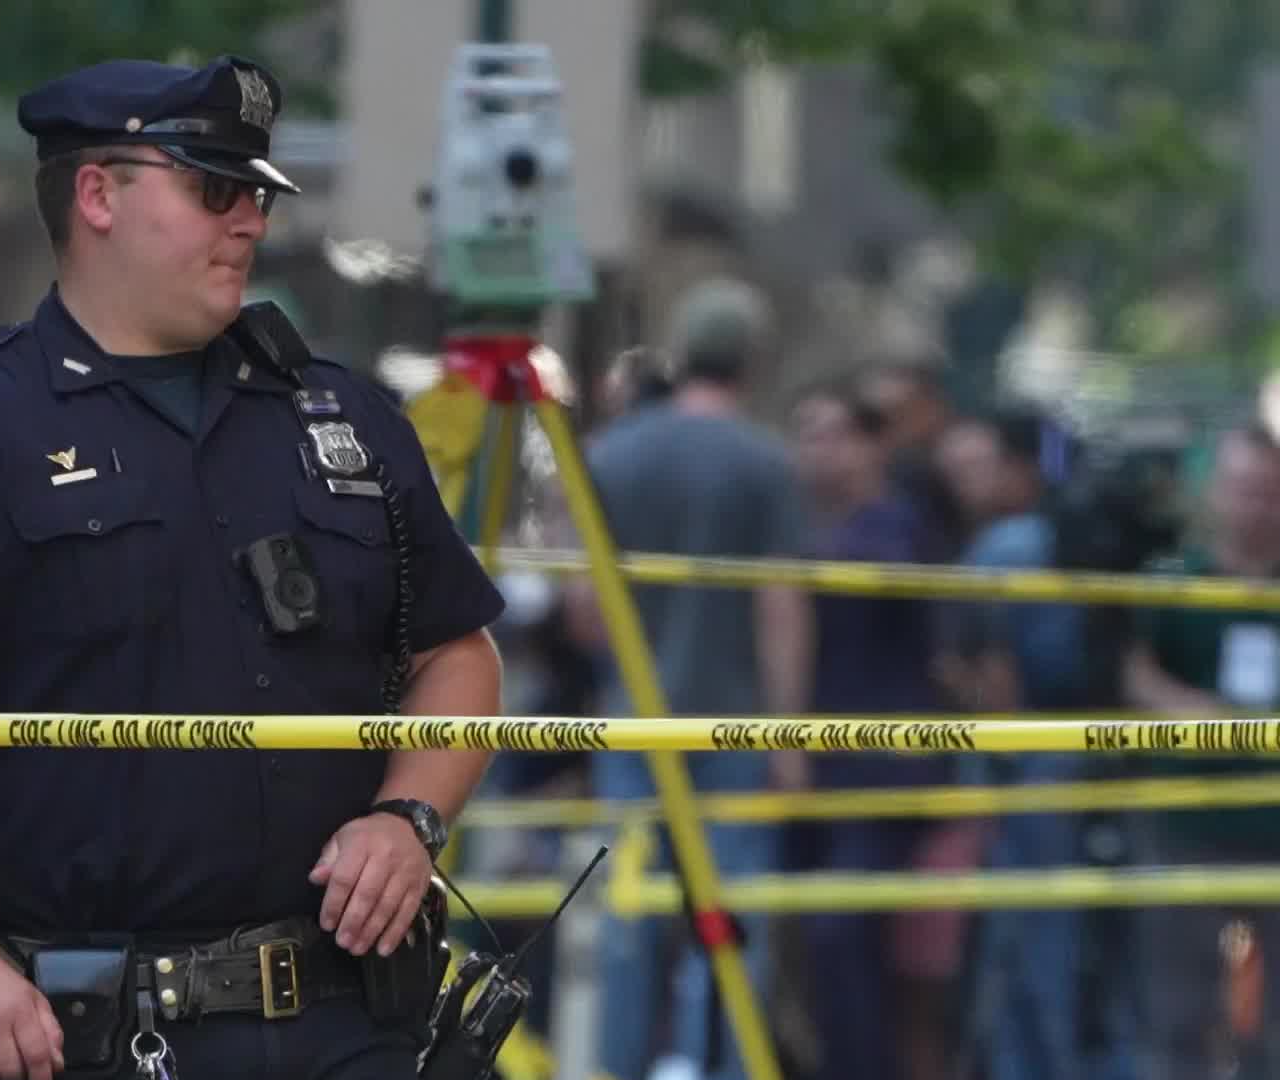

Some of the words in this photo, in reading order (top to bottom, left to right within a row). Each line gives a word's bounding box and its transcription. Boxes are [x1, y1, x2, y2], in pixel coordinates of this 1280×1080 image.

[9, 720, 52, 746] FIRE
[112, 720, 142, 748] DO
[146, 721, 184, 749] NOT
[190, 721, 256, 749] CROSS
[359, 721, 404, 749] FIRE
[464, 722, 495, 750] DO
[497, 722, 540, 751] NOT
[541, 722, 608, 751] CROSS
[712, 723, 760, 751] FIRE
[820, 723, 853, 751] DO
[855, 723, 903, 751] NOT
[904, 723, 976, 751] CROSS
[1085, 724, 1131, 750] FIRE
[1196, 723, 1223, 749] DO
[1231, 722, 1268, 750] NOT
